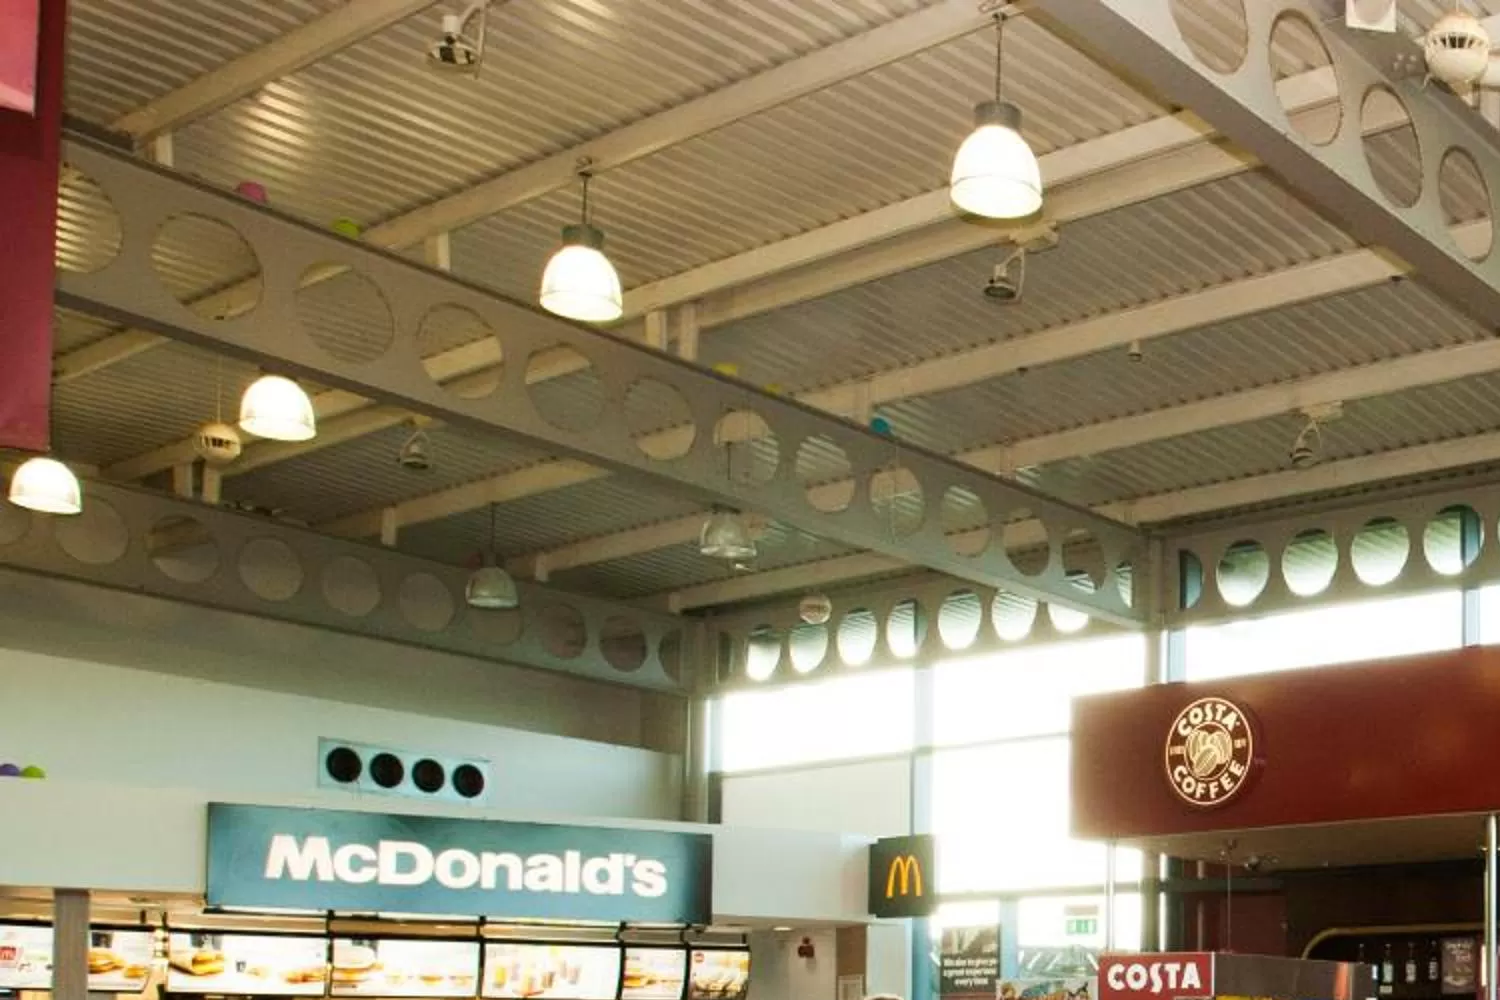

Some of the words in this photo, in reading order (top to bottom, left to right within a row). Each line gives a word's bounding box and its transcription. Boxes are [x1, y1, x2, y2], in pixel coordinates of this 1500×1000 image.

[1178, 703, 1238, 736] COSTA
[1174, 760, 1244, 798] COFFEE
[265, 834, 667, 898] McDonald's
[1107, 962, 1201, 993] COSTA
